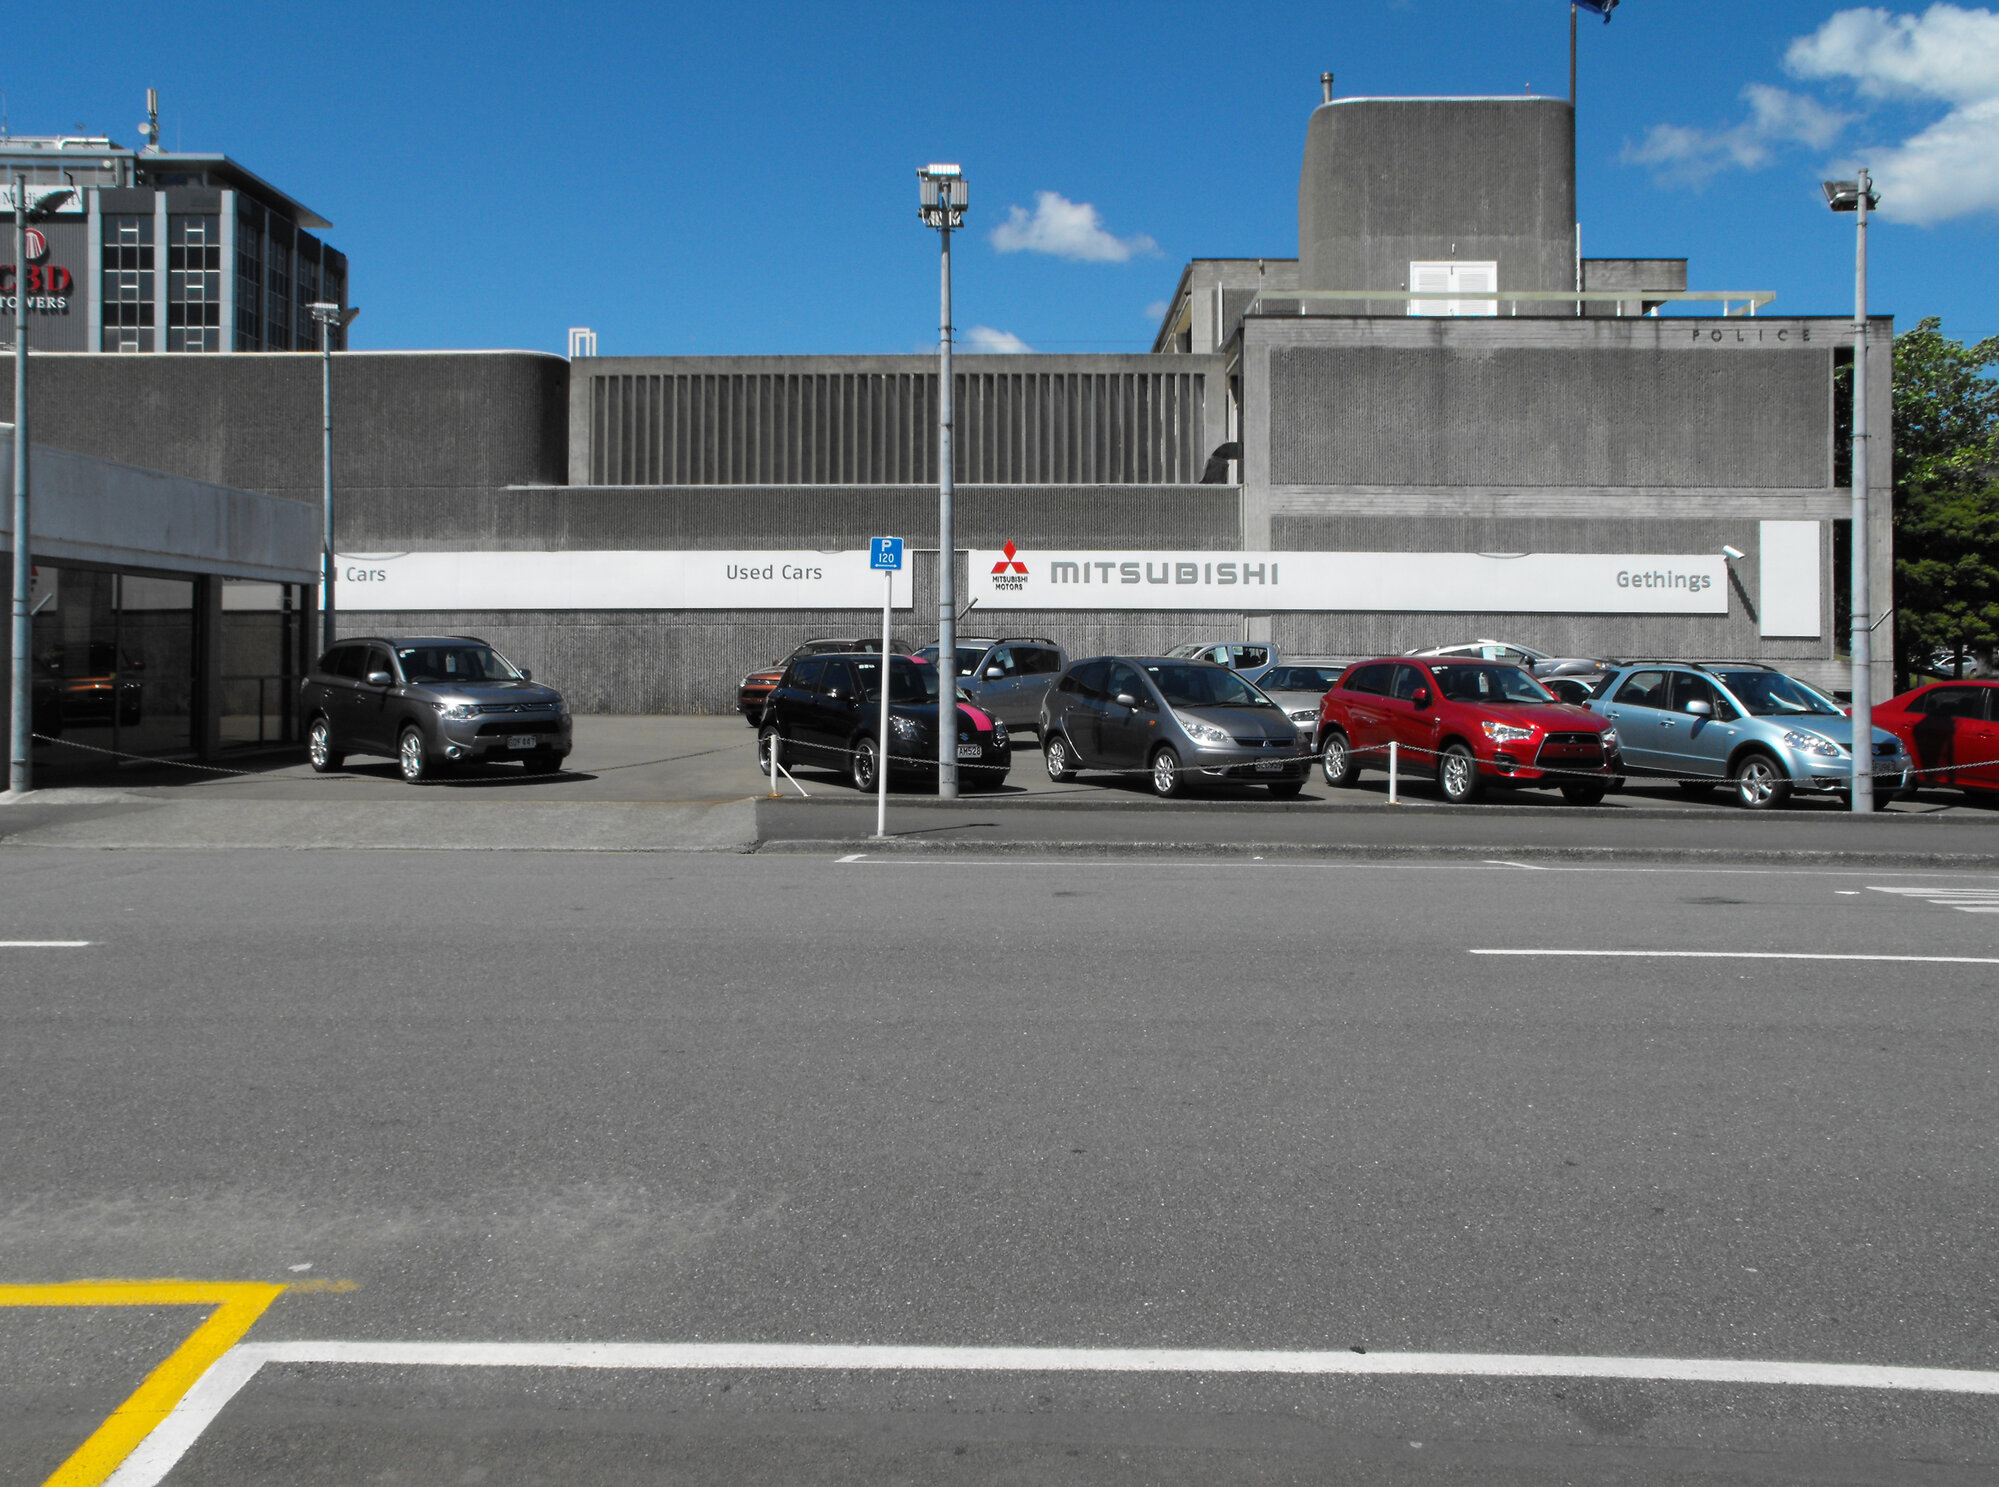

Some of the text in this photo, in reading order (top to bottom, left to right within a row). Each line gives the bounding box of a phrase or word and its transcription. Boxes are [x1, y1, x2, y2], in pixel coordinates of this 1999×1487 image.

[0, 264, 70, 291] CBD
[1692, 329, 1811, 342] POLICE
[881, 539, 892, 552] P
[879, 553, 895, 563] 120
[346, 566, 386, 582] Cars
[726, 565, 823, 580] Used Cars
[1051, 562, 1279, 585] MITSUBISHI
[1616, 570, 1711, 592] Gethings
[957, 746, 980, 756] AM528
